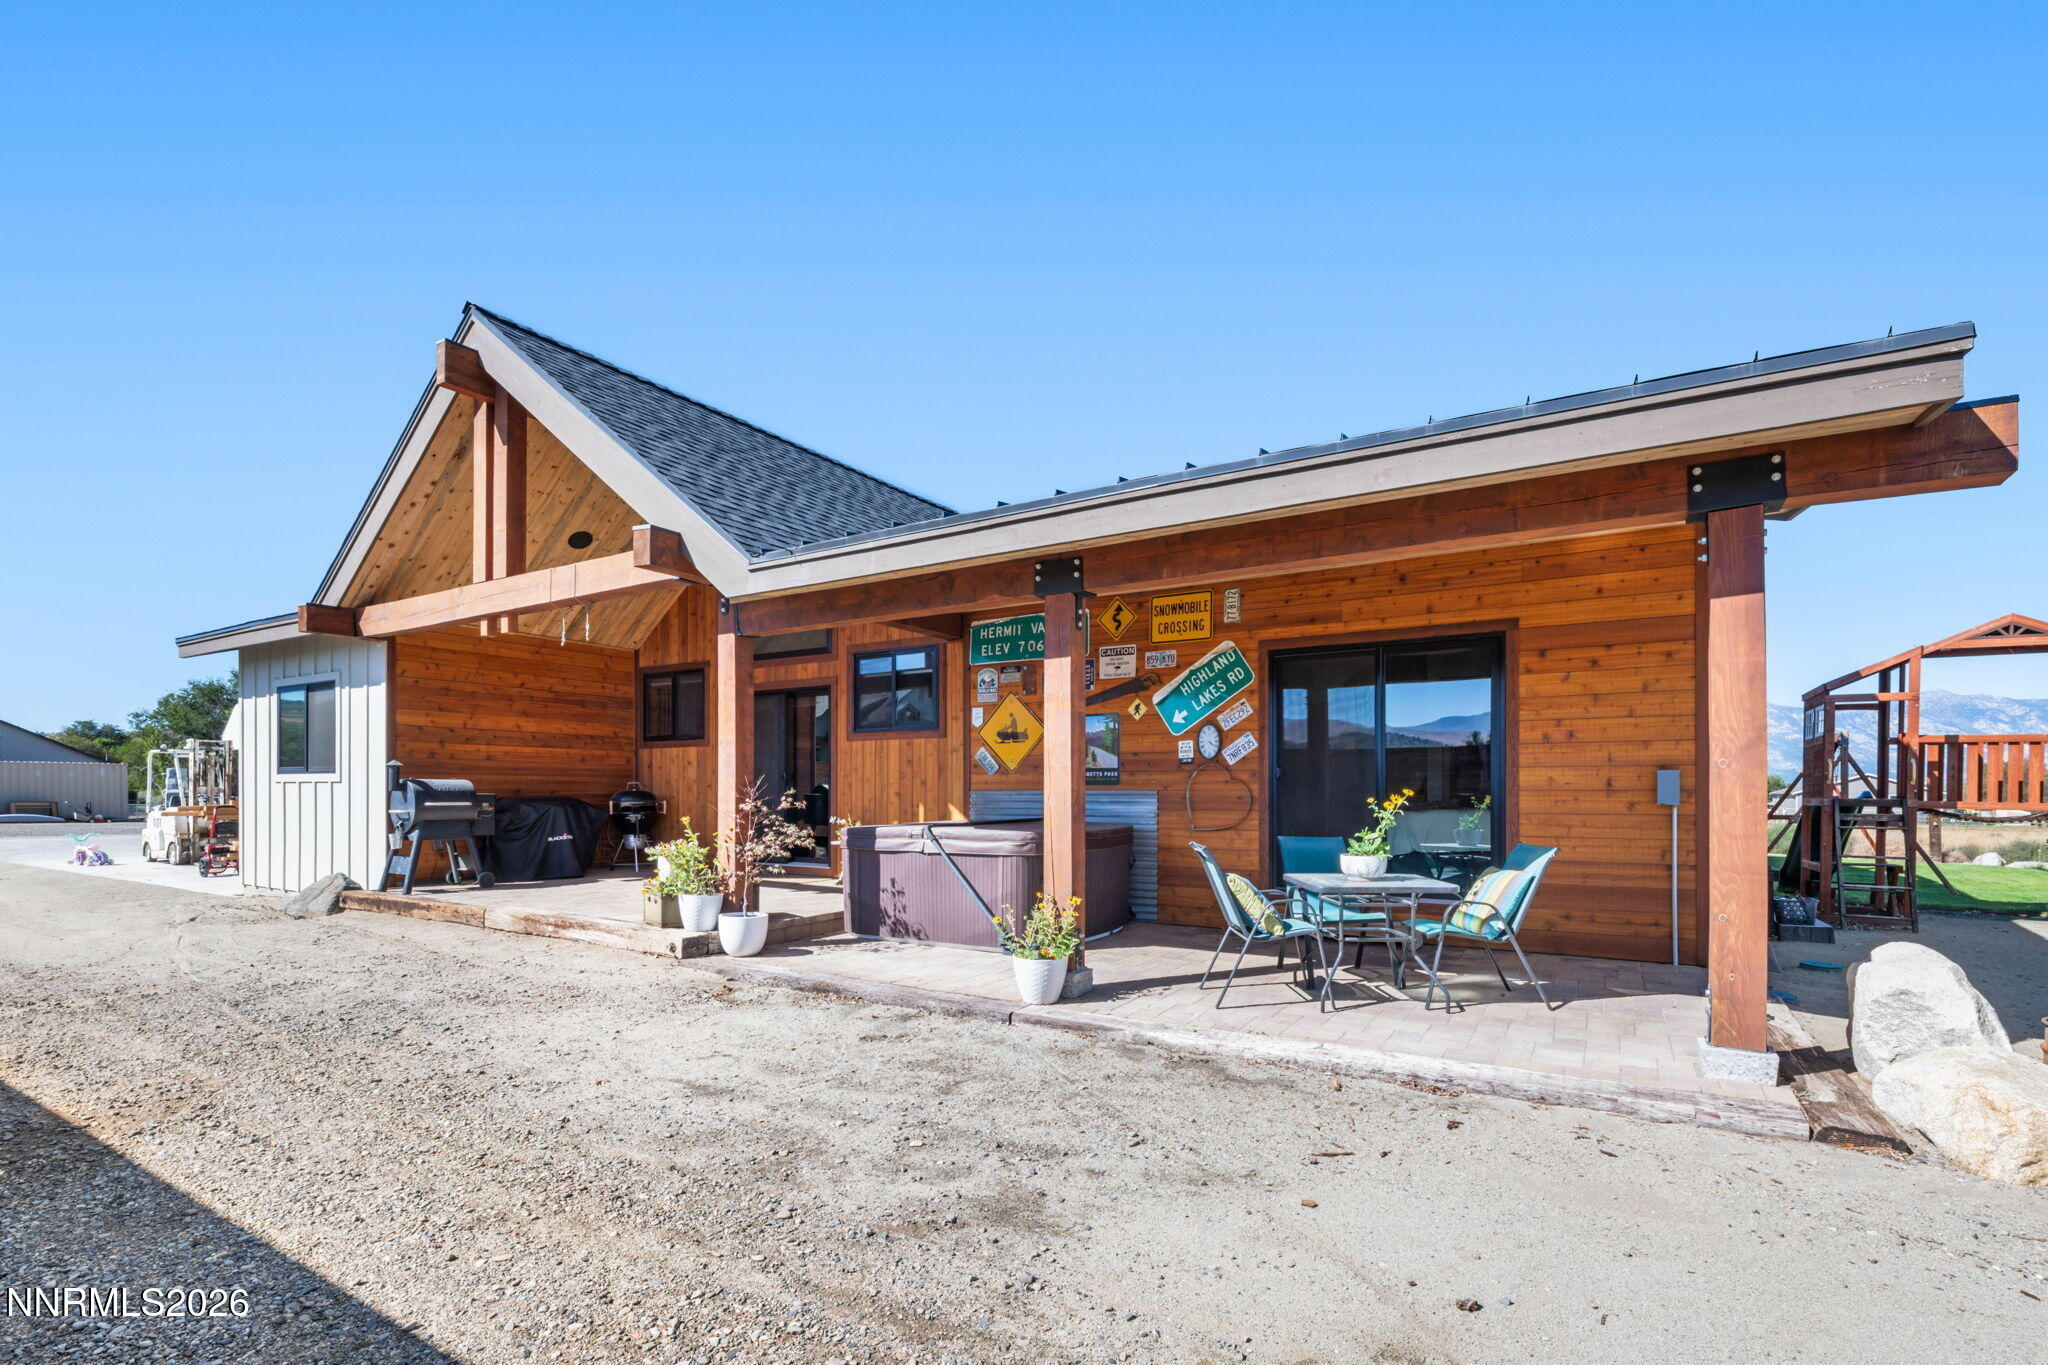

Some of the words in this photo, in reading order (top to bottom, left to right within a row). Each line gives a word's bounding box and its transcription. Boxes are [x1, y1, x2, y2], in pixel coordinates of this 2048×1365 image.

[1154, 600, 1209, 617] SNOWMOBILE
[1030, 622, 1045, 635] VA
[1158, 619, 1205, 635] CROSSING
[981, 643, 1010, 656] ELEV
[1018, 640, 1044, 653] 706
[1101, 647, 1135, 656] CAUTION
[1146, 655, 1158, 664] 859
[1162, 654, 1175, 663] KYU
[1179, 651, 1236, 696] HIGHLAND
[1191, 680, 1227, 711] LAKES
[1227, 667, 1245, 685] RD
[1226, 738, 1255, 762] 7NRF835
